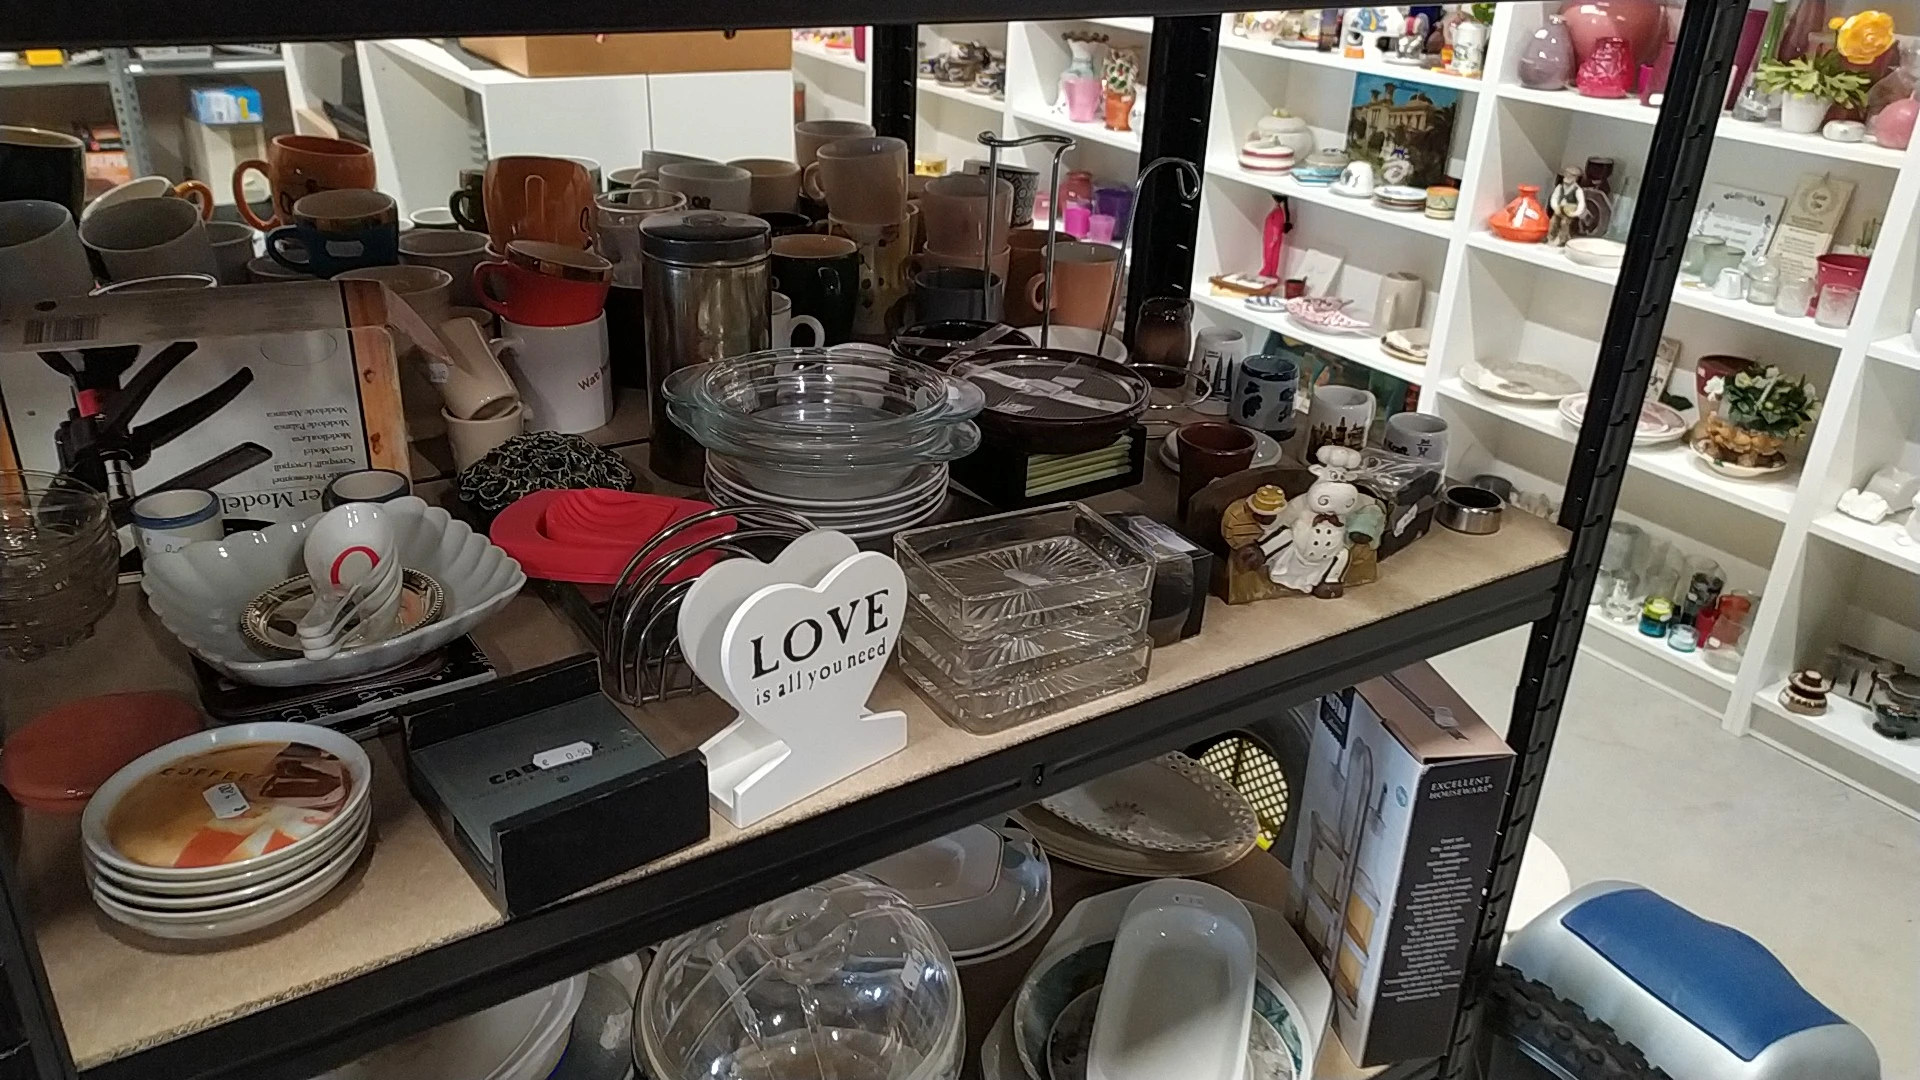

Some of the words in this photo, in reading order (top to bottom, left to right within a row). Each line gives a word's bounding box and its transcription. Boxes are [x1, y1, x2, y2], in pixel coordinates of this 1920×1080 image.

[578, 372, 600, 390] Wat
[221, 491, 295, 514] Model
[750, 589, 889, 680] LOVE
[756, 688, 771, 706] is
[778, 670, 801, 697] all
[808, 660, 842, 690] you
[847, 637, 886, 669] need
[1431, 776, 1492, 791] EXCELLENT
